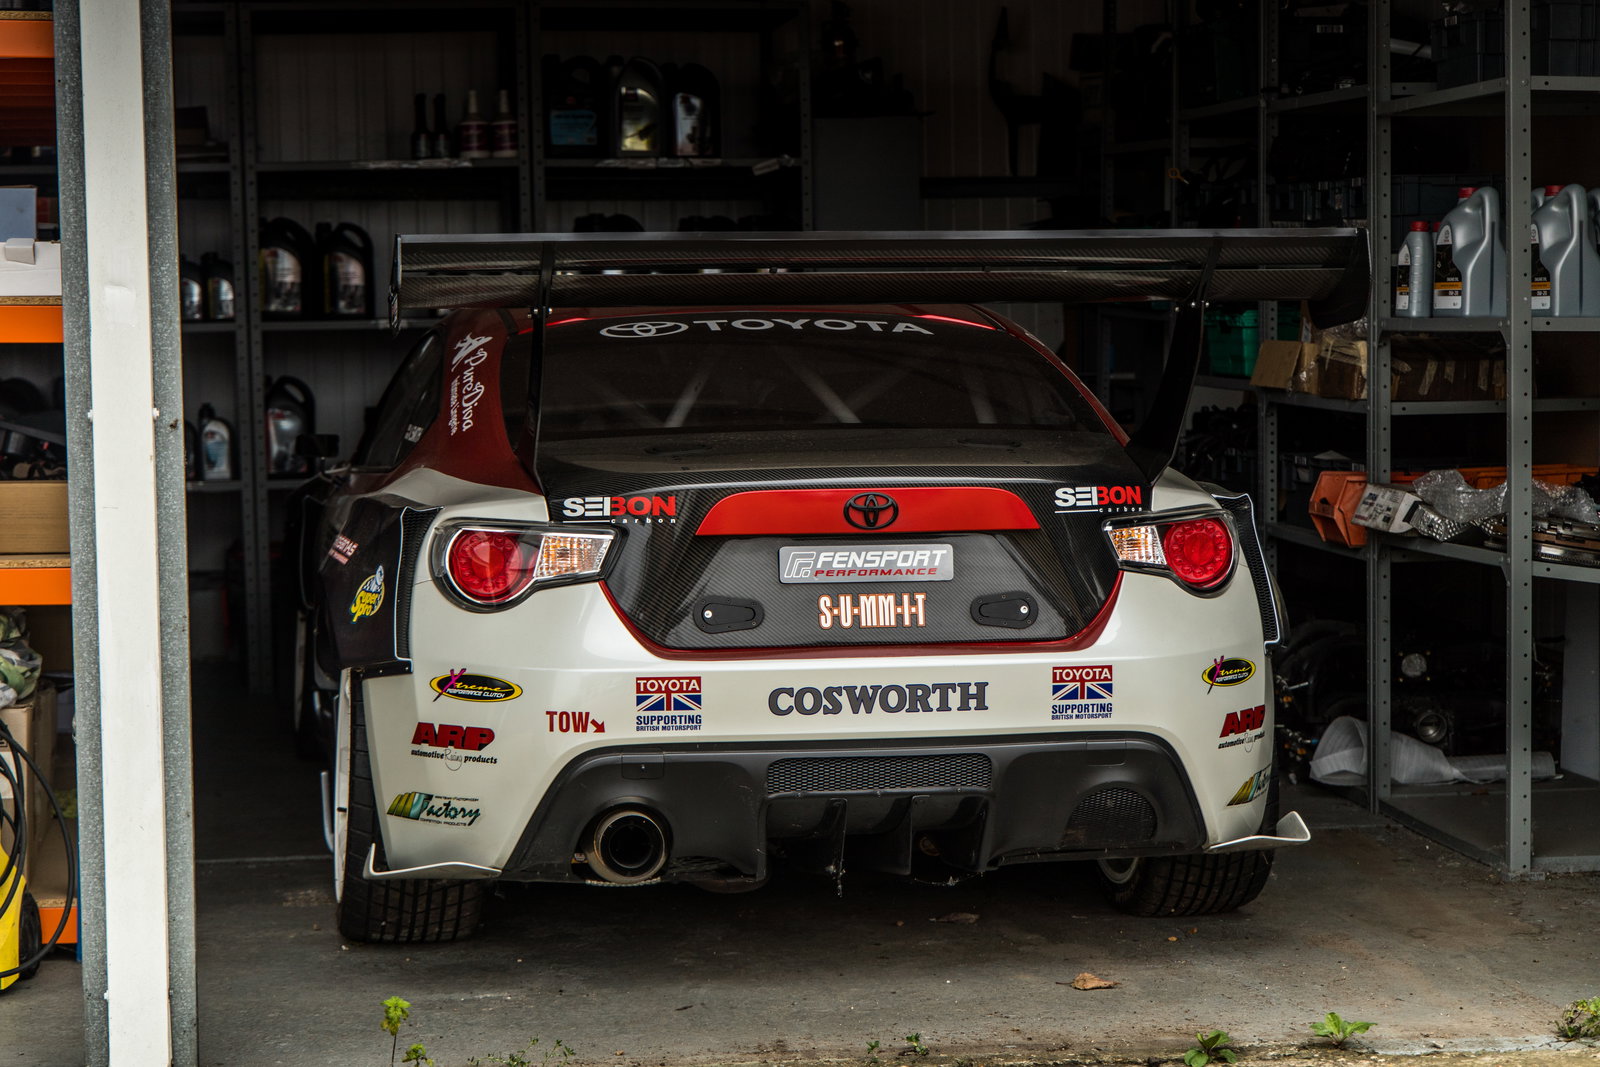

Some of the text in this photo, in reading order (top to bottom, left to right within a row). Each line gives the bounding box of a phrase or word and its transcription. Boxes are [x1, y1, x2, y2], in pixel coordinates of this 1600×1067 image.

[693, 319, 935, 336] TOYOTA
[1054, 485, 1142, 507] SEIBON
[562, 496, 676, 517] SEIBON
[816, 550, 947, 569] FENSPORT
[813, 567, 938, 577] PERFORMANCE
[1053, 668, 1112, 681] TOYOTA
[433, 668, 513, 702] Xtreme
[636, 679, 700, 692] TOYOTA
[768, 682, 989, 716] COSWORTH
[1051, 703, 1113, 715] SUPPORTING
[545, 710, 590, 734] TOW
[636, 714, 702, 725] SUPPORTING
[661, 724, 702, 732] MOTORSPORT
[411, 722, 496, 751] ARP
[411, 749, 445, 760] automotive
[463, 755, 498, 765] products
